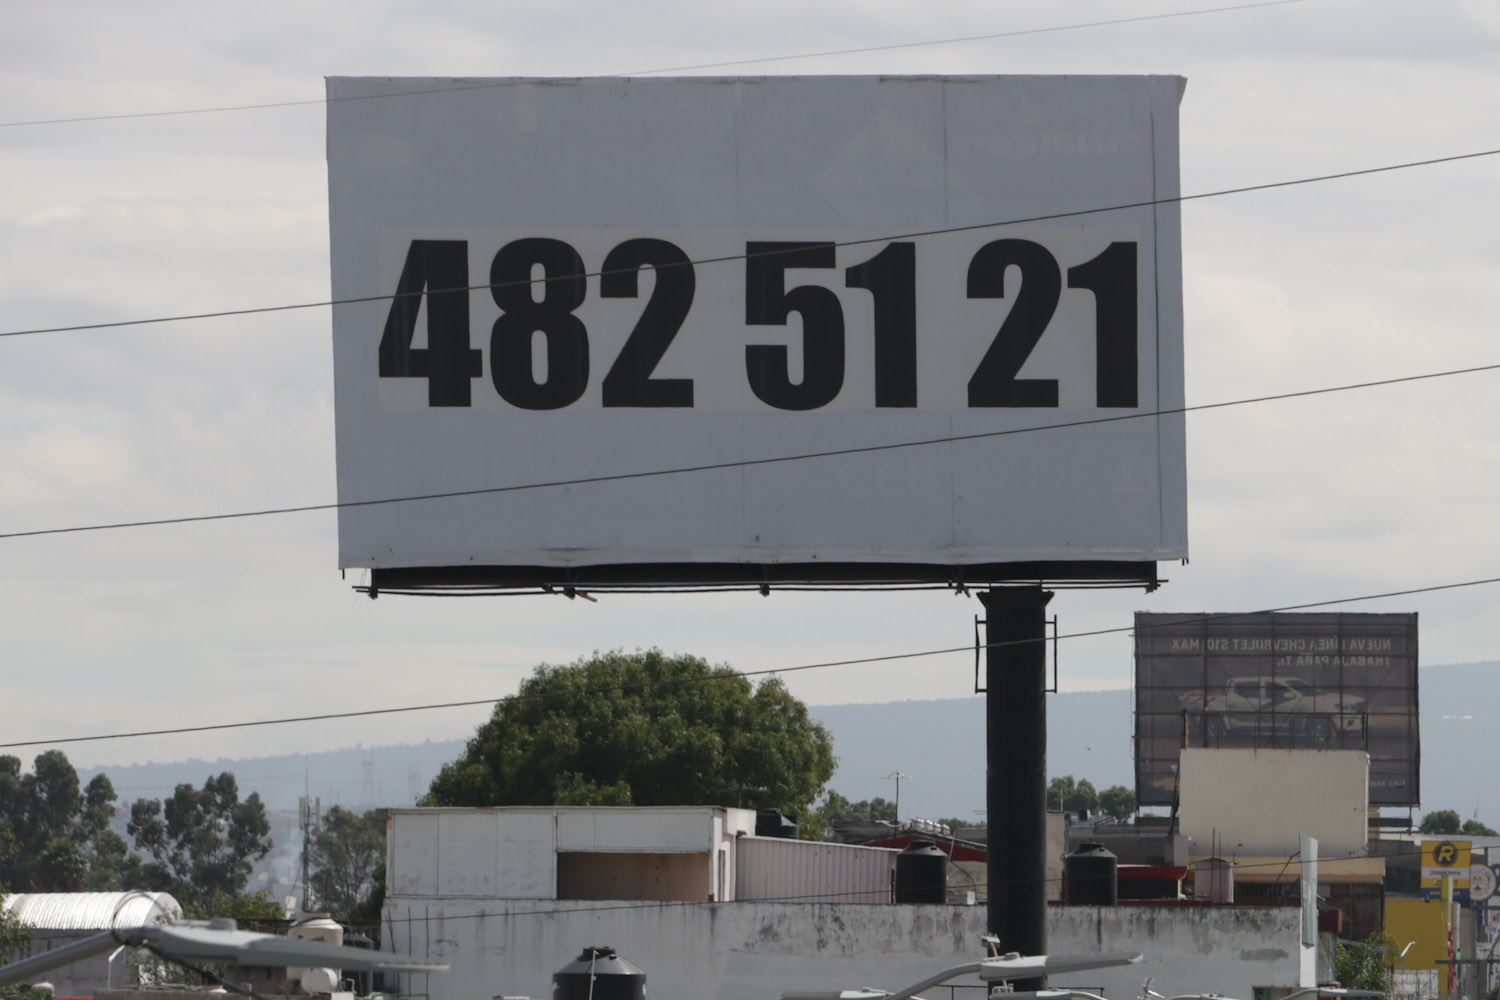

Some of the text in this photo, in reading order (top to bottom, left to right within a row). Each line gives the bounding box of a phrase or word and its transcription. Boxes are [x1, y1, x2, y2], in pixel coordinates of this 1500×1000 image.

[377, 236, 1140, 412] 482 51 21
